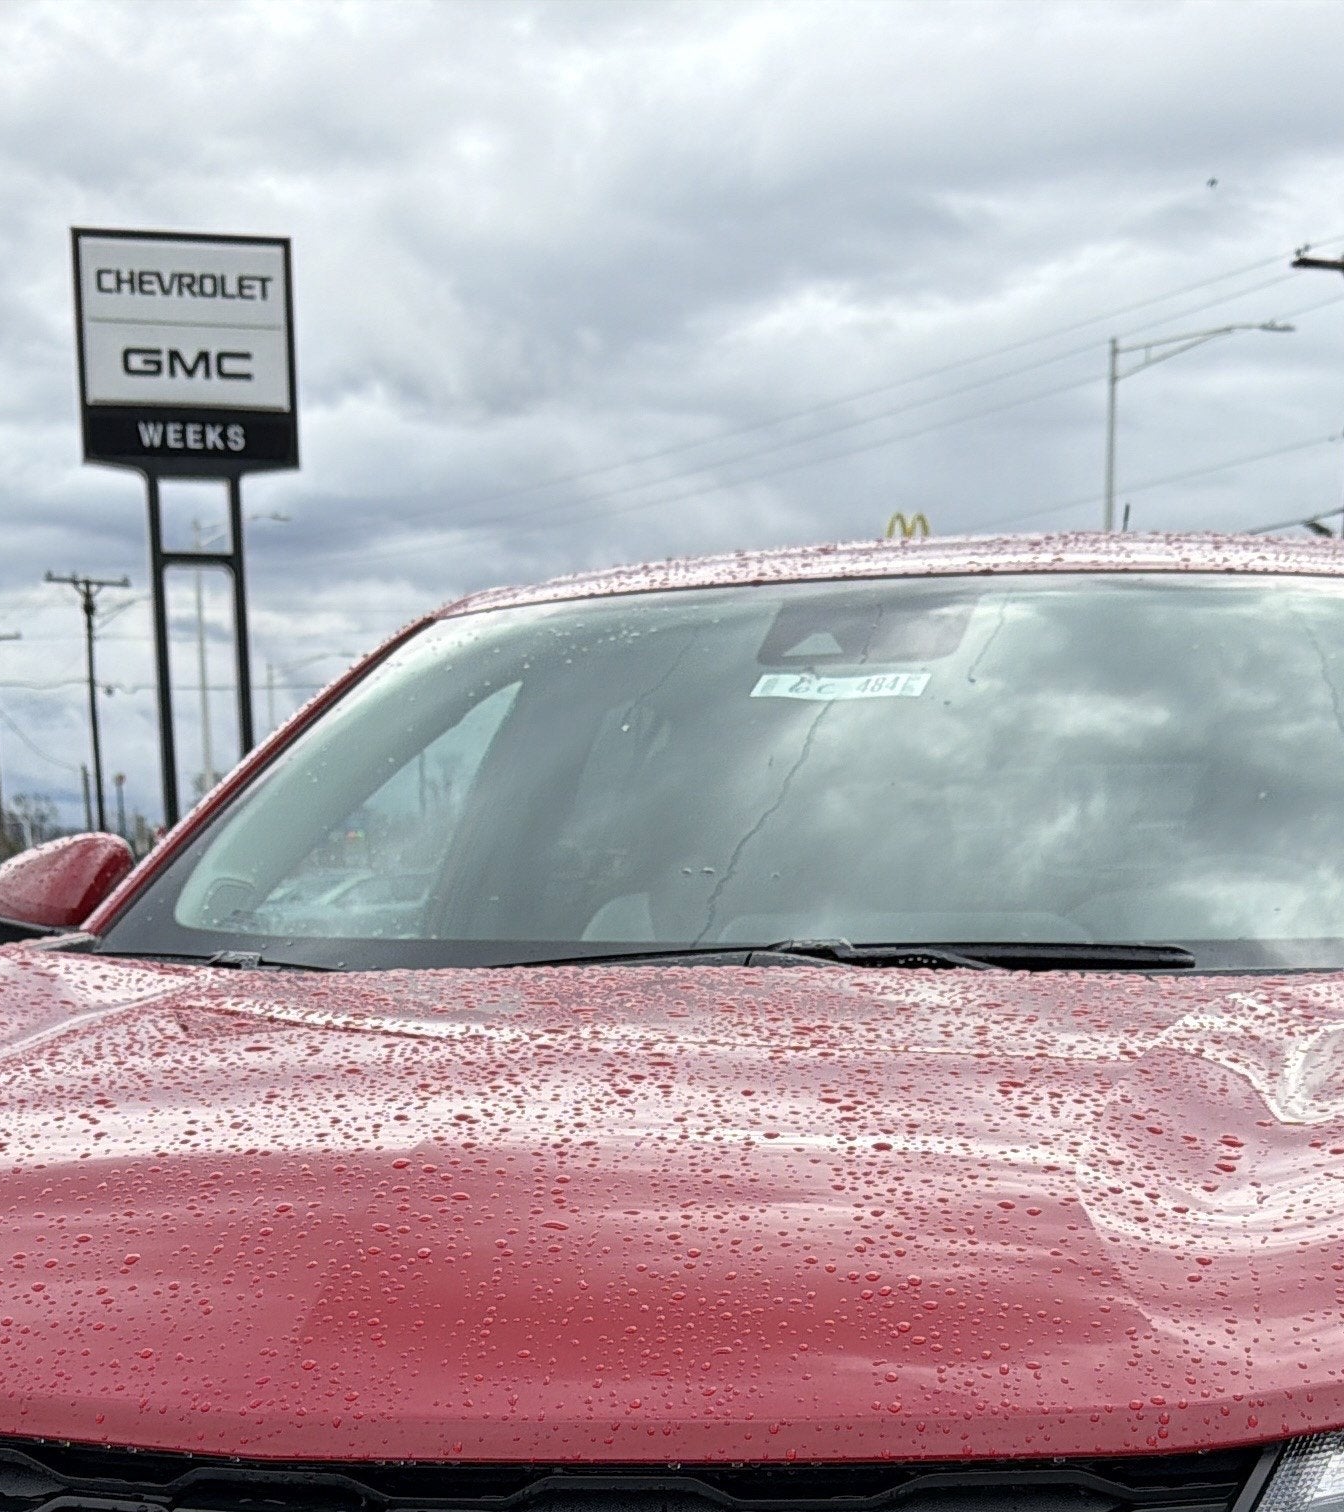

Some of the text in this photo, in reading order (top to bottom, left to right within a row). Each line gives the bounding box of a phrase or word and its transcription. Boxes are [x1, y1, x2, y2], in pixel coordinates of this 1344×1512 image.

[95, 269, 273, 300] CHEVROLET
[122, 348, 254, 380] GMC
[137, 421, 247, 451] WEEKS
